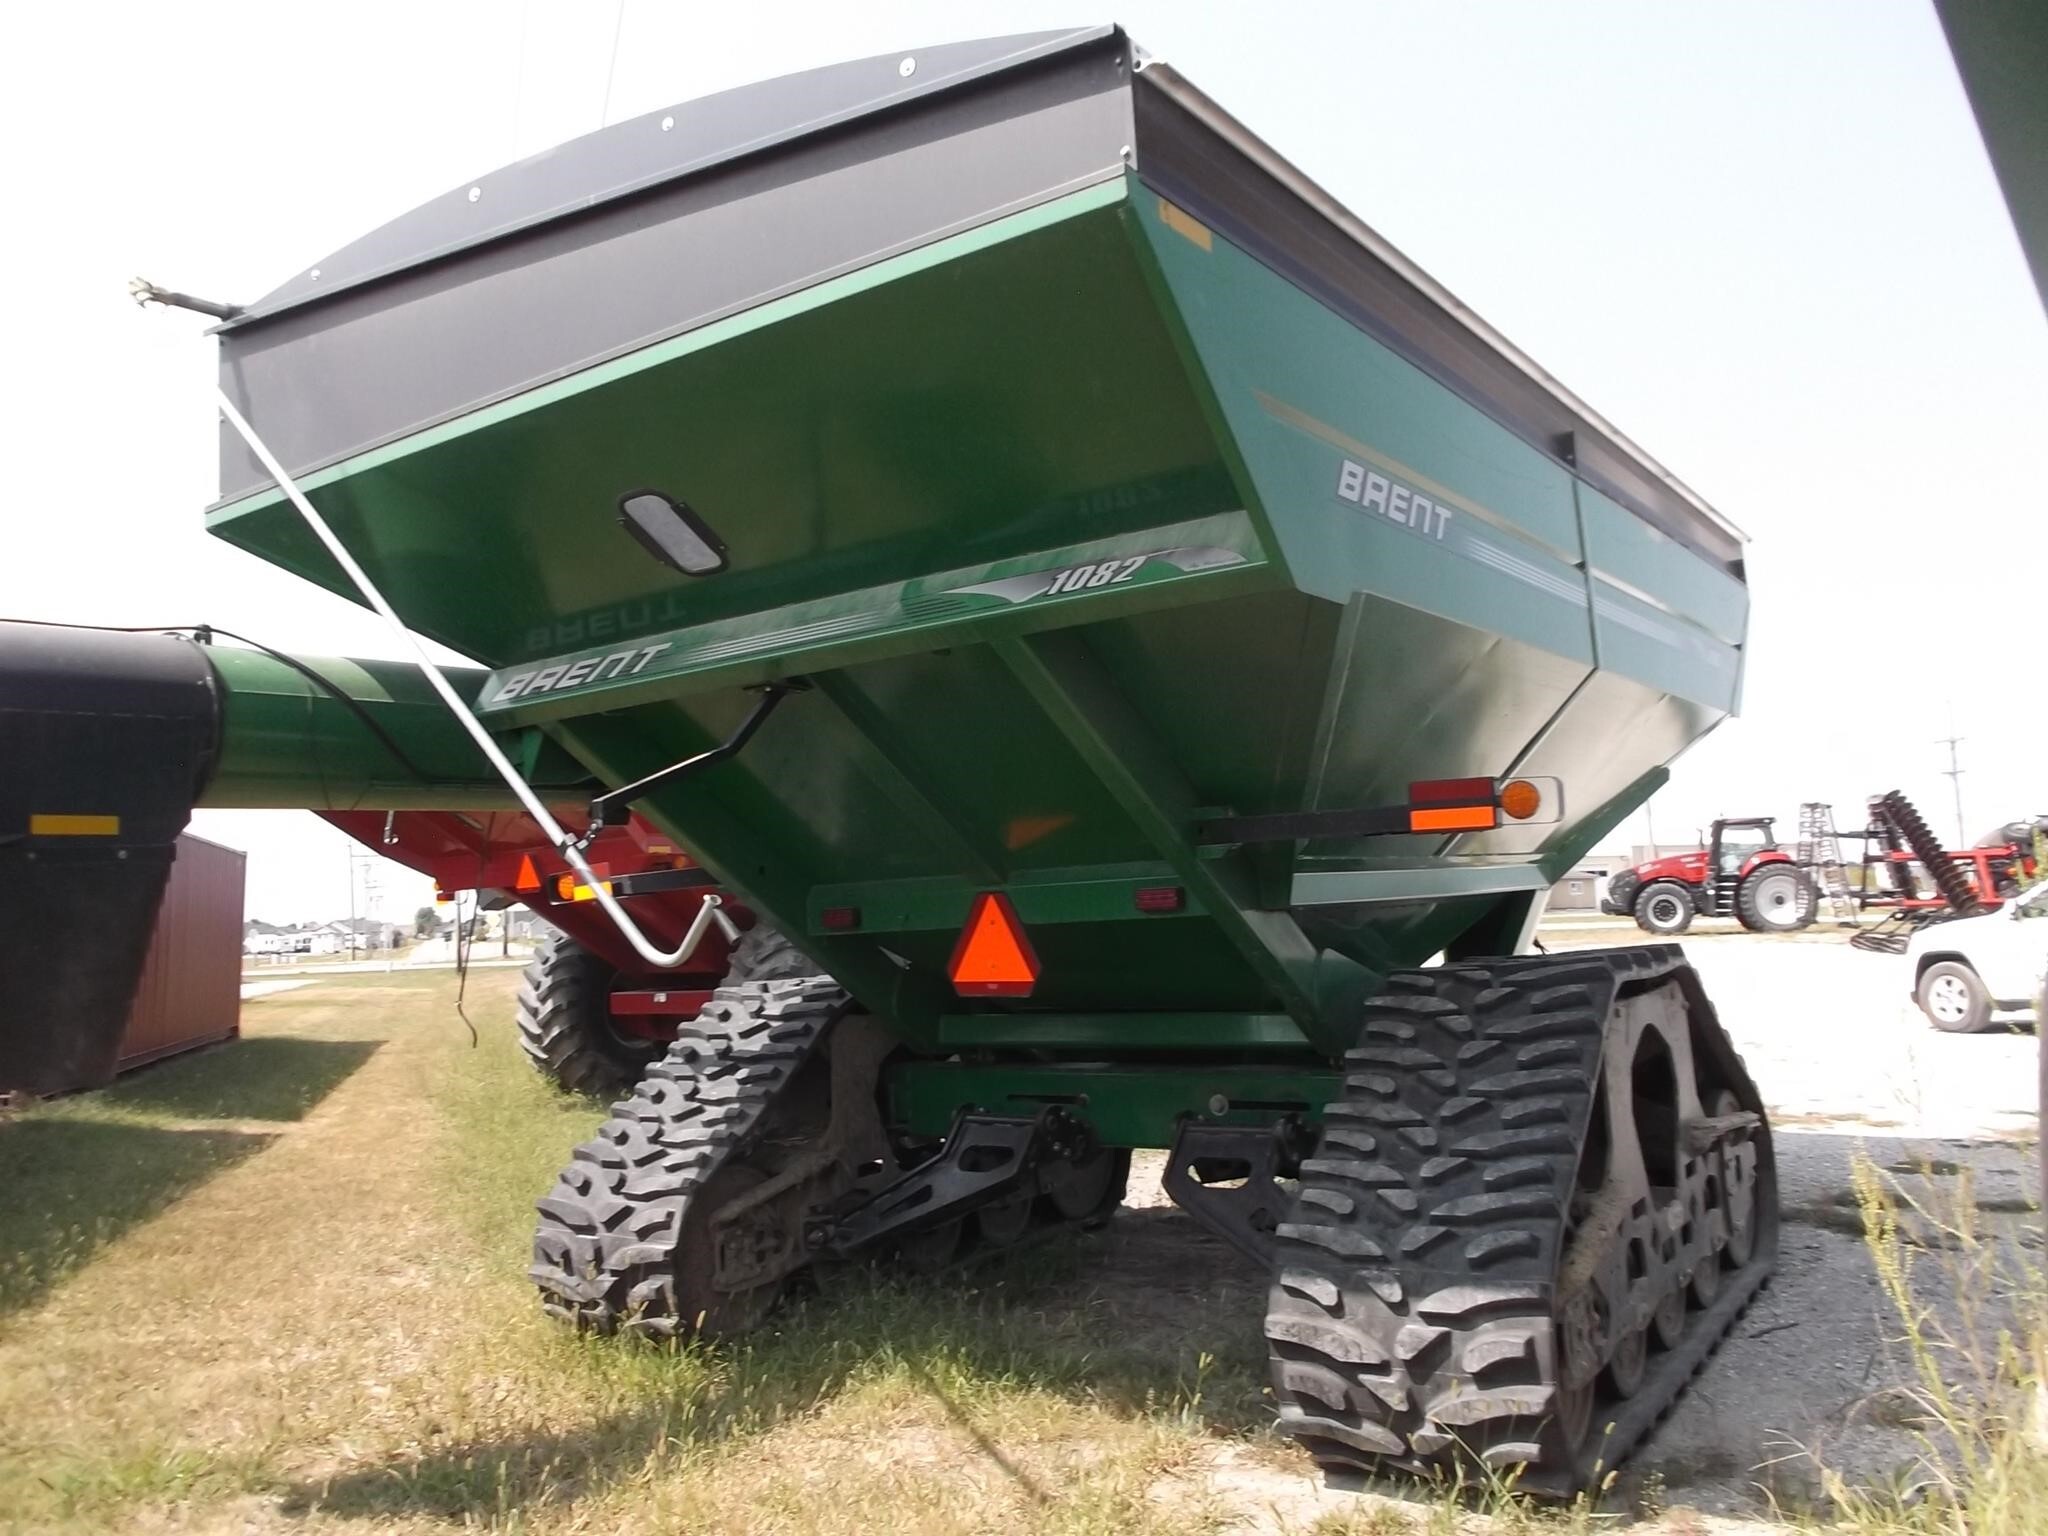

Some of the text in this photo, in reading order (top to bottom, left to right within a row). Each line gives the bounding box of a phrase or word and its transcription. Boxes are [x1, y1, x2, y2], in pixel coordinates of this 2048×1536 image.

[1338, 459, 1452, 540] BRENT
[1046, 555, 1147, 596] 1082
[492, 642, 673, 702] BRENT
